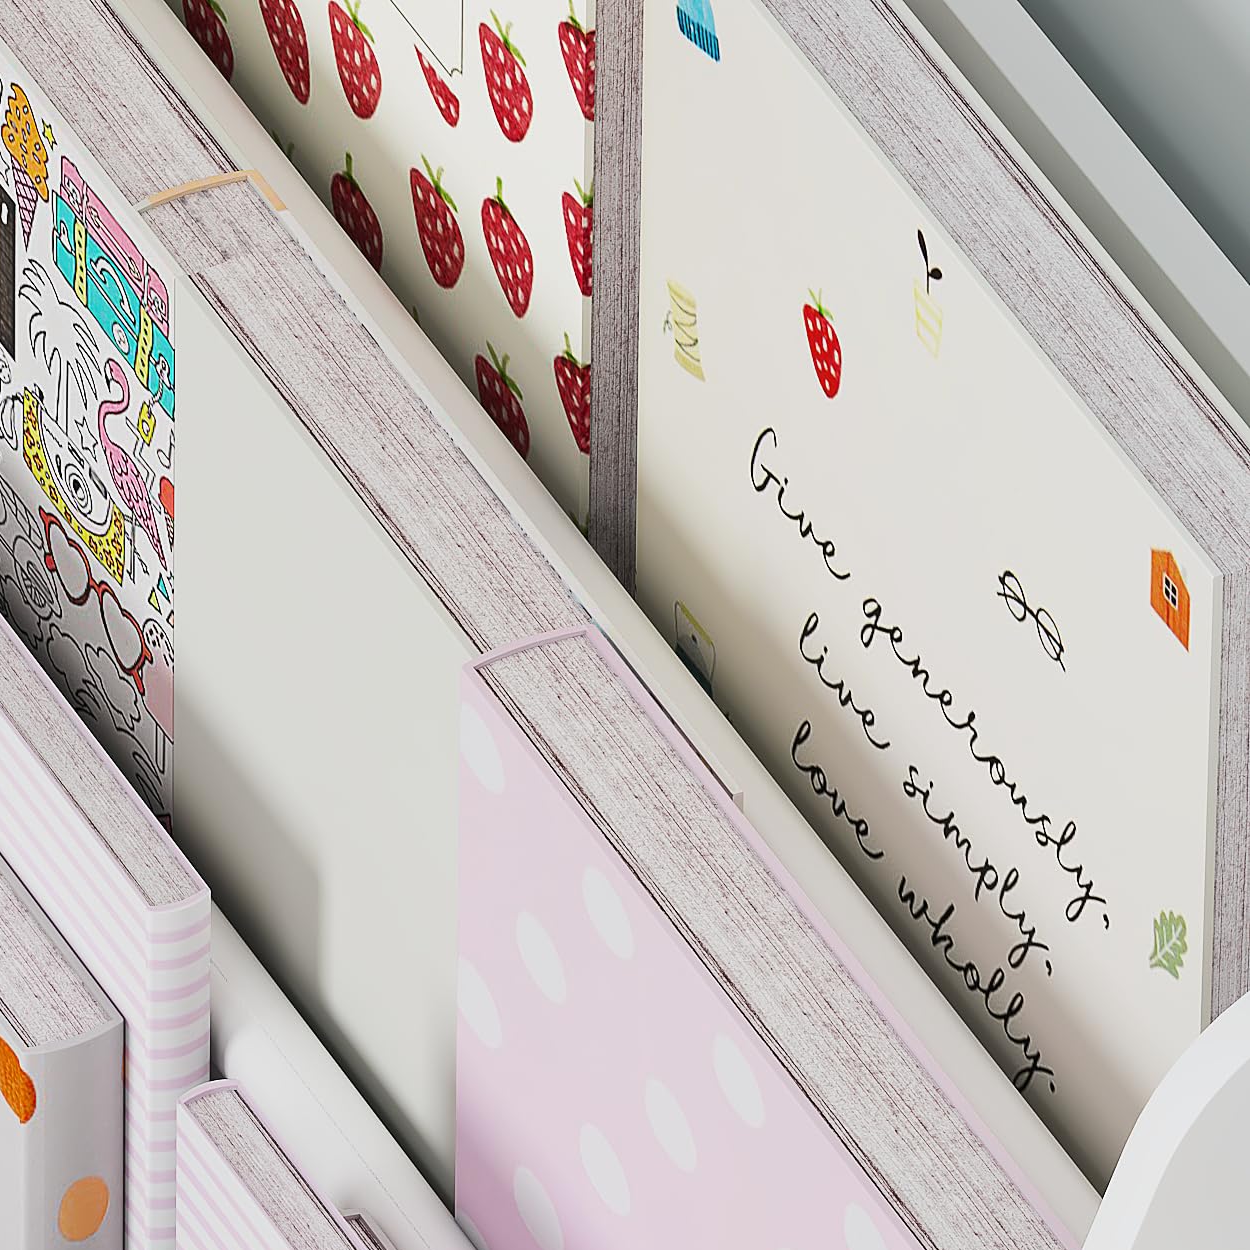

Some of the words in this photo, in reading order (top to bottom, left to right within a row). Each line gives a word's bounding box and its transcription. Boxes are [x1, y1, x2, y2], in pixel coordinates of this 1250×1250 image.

[750, 427, 851, 580] Give
[860, 597, 1110, 930] generously,
[798, 611, 891, 750] live
[903, 765, 1053, 977] simply,
[791, 720, 885, 860] love
[897, 876, 1057, 1094] wholly.
